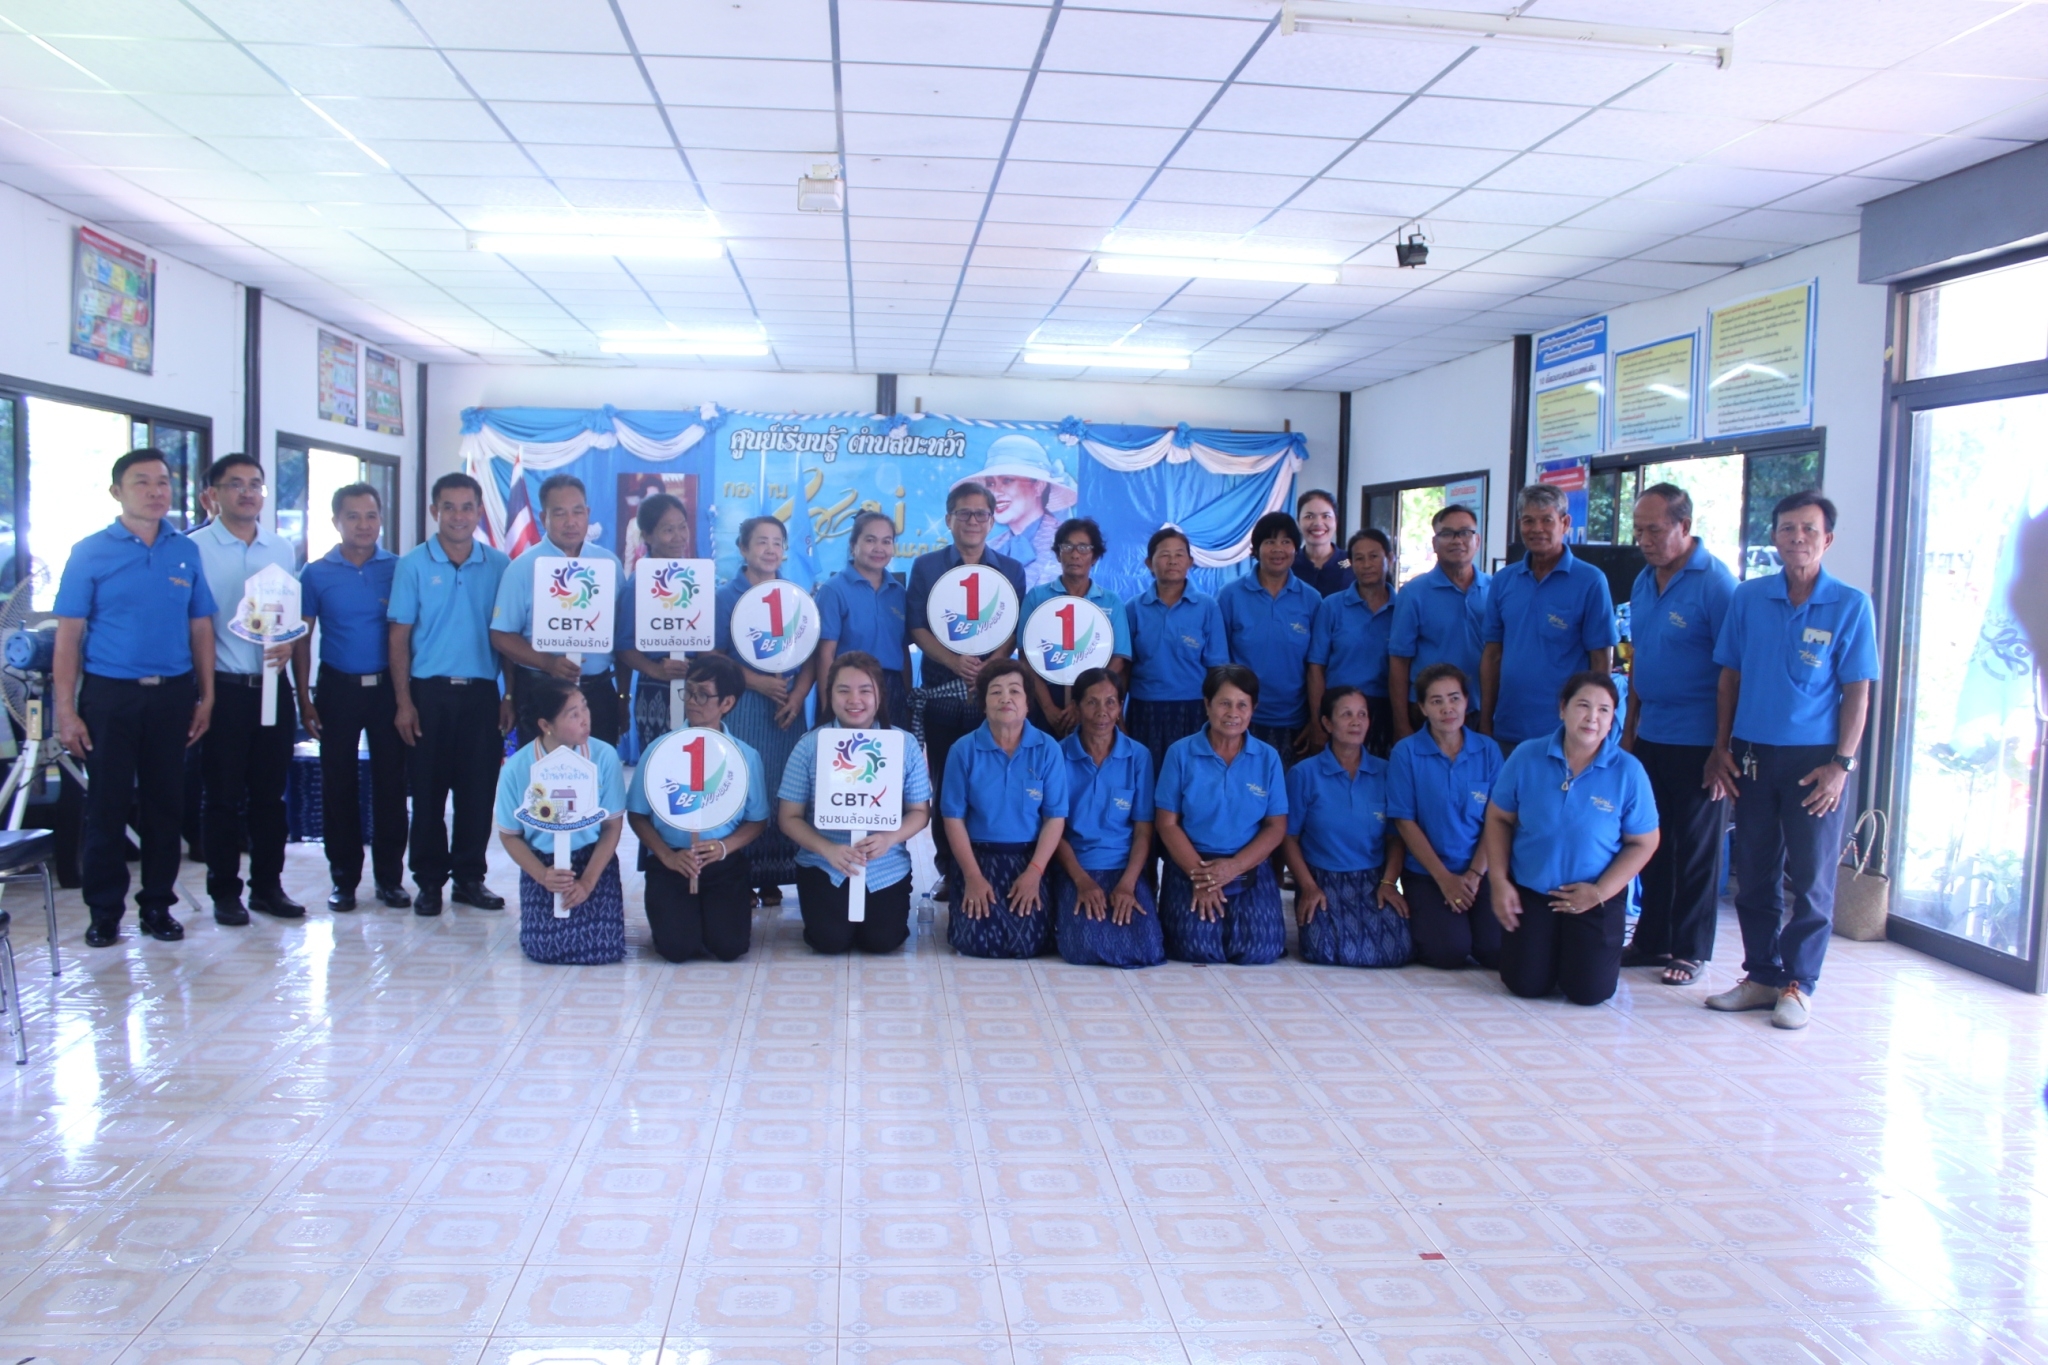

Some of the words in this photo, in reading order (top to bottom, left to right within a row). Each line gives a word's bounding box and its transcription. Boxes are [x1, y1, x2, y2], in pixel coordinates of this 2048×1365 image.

[729, 422, 848, 463] ศูนย์เรียนรู้
[960, 573, 979, 620] 1
[762, 588, 784, 638] 1
[954, 621, 972, 634] BE
[1055, 604, 1075, 651] 1
[536, 637, 609, 649] ชุมชนล้อมรักษ์
[640, 636, 711, 649] ชุมชนล้อมรักษ์
[760, 639, 777, 652] BE
[1050, 651, 1068, 664] BE
[682, 736, 705, 792] 1
[676, 793, 697, 808] BE
[819, 813, 897, 826] ชุมชนล้อมรักษ์
